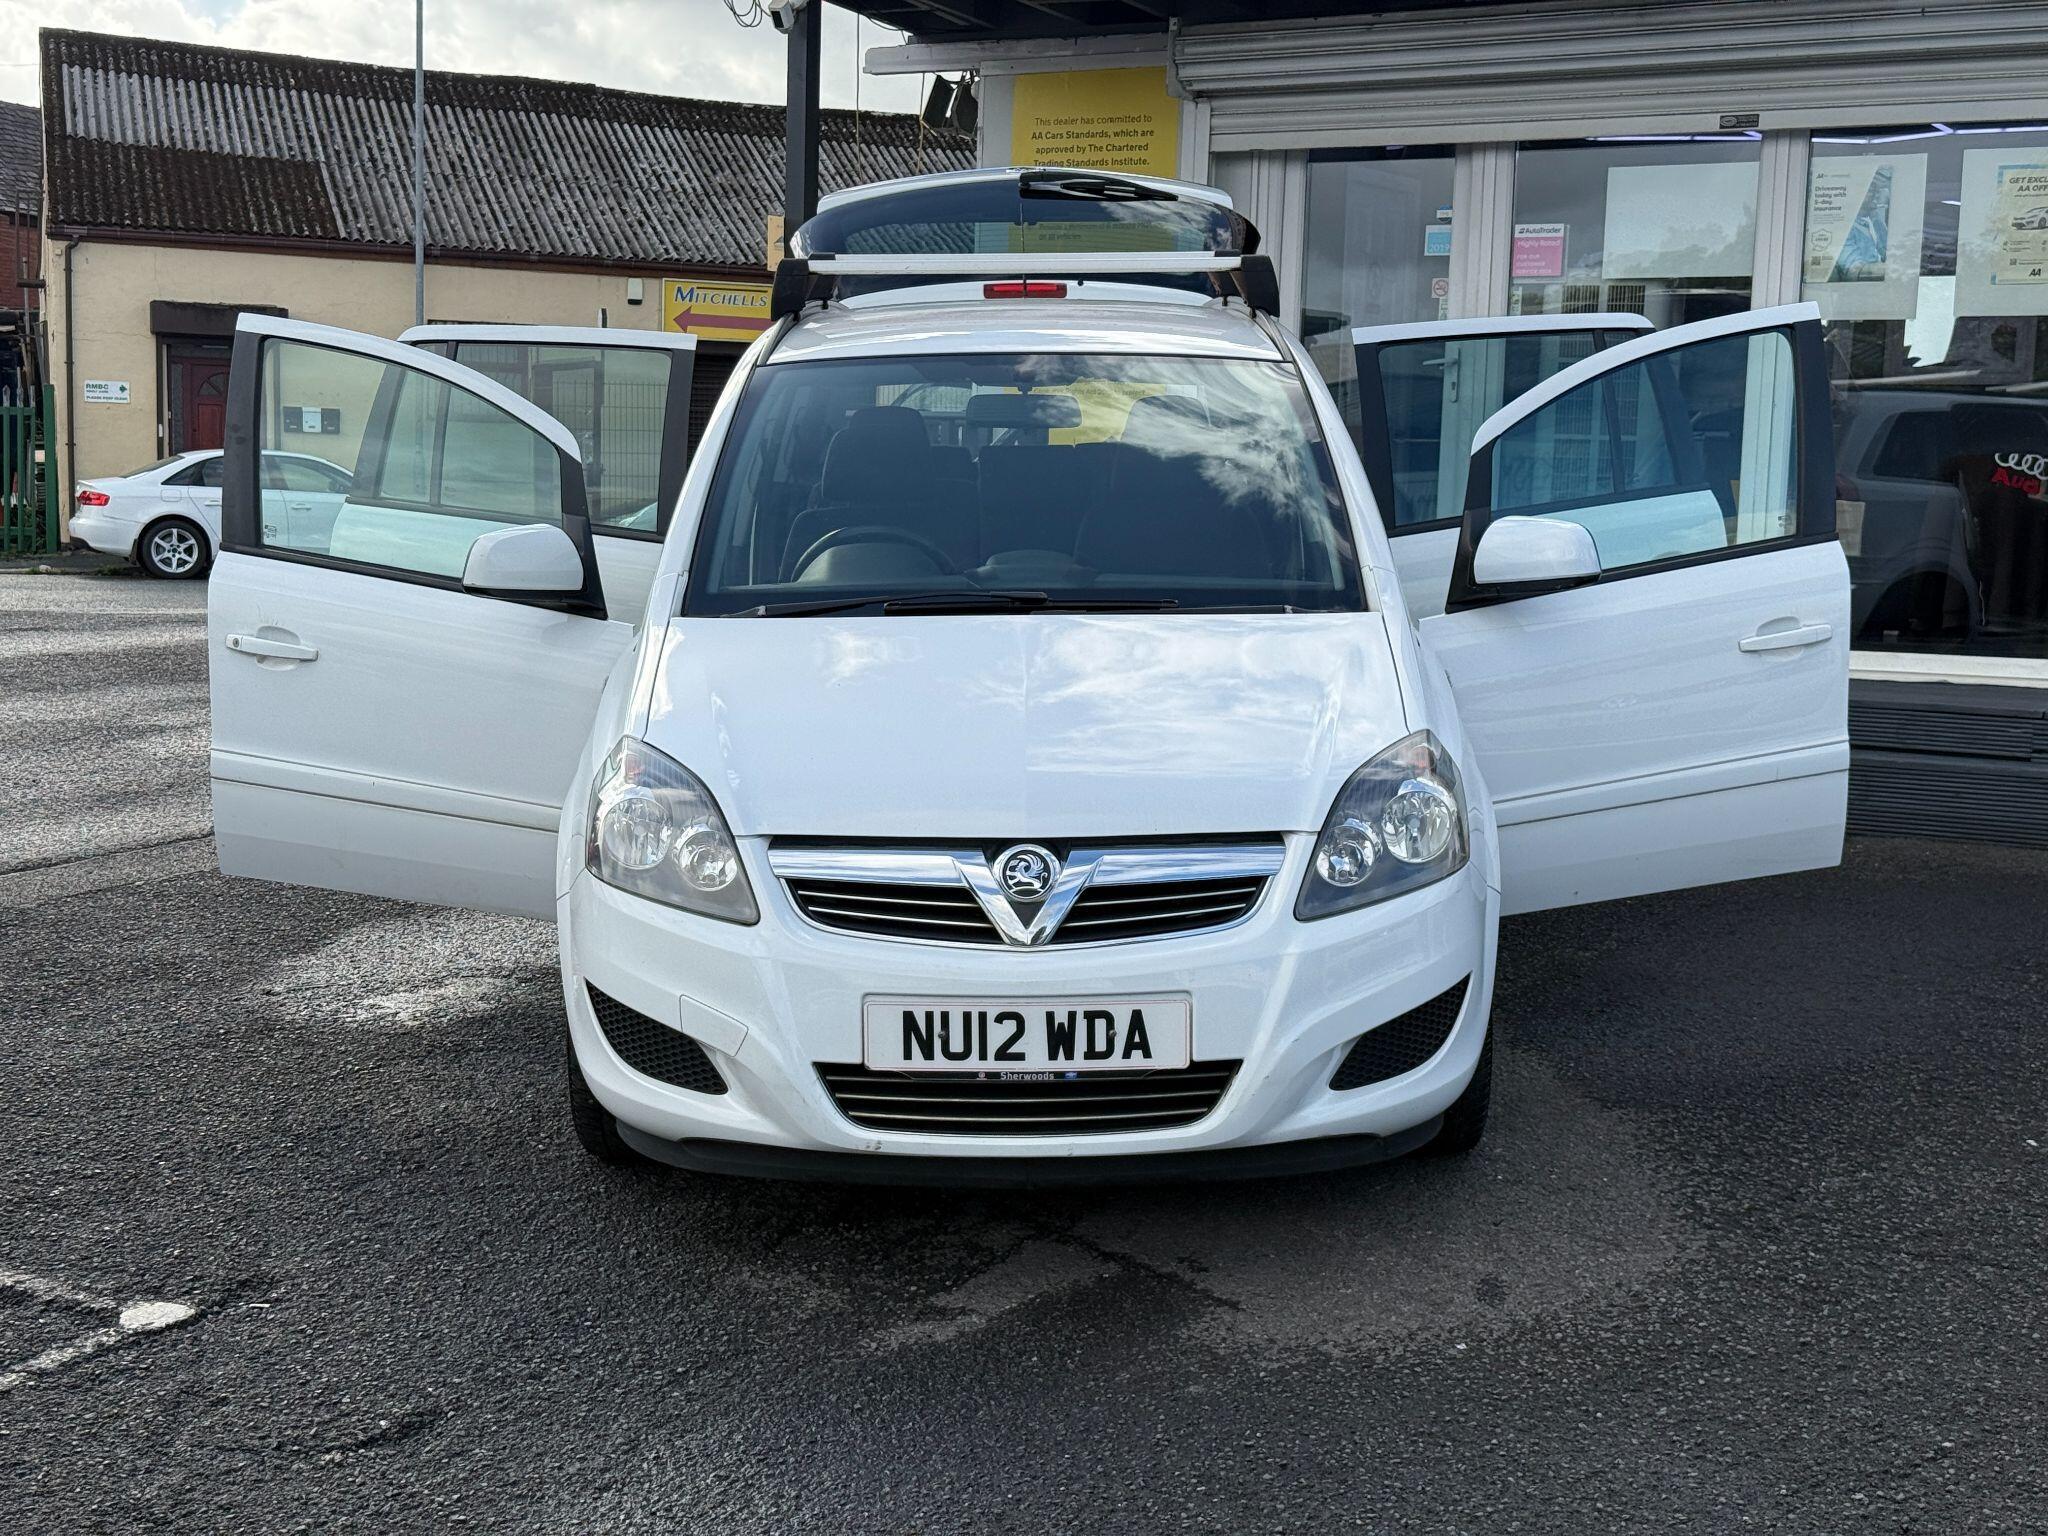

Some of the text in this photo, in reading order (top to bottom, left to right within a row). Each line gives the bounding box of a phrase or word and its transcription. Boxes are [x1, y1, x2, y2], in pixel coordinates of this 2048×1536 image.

[1035, 114, 1152, 126] This dealer has committed to
[1031, 128, 1155, 140] AA Cars Standards, which are
[1035, 142, 1149, 155] approved by The Chartered
[1033, 156, 1150, 167] Trading Standards Institute.
[2009, 176, 2026, 184] GET
[1814, 191, 1847, 200] today with
[1525, 226, 1562, 234] AutoTrader
[2028, 268, 2042, 277] AA
[674, 286, 768, 307] MITCHELLS
[902, 1009, 1152, 1062] NU12 WDA
[1000, 1071, 1055, 1081] Sherwoods
